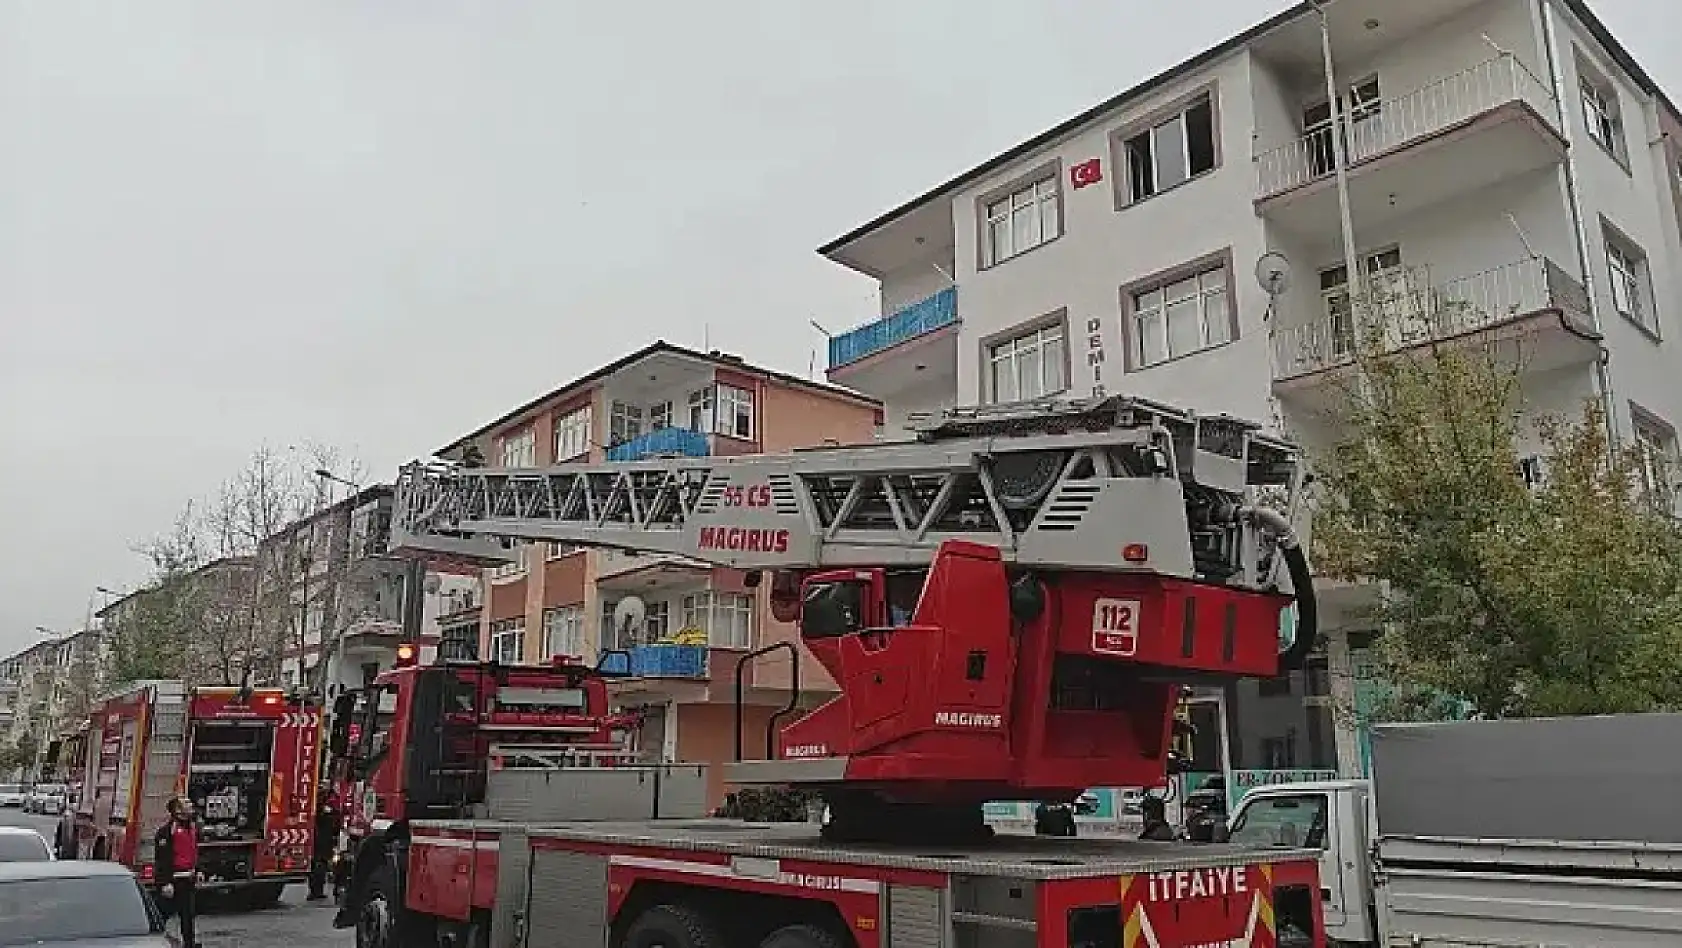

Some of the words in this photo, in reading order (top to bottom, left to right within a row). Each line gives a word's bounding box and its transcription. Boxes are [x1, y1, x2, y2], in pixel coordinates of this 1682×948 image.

[748, 484, 771, 507] CS
[698, 527, 790, 552] MAGIRUS
[1101, 604, 1132, 631] 112
[935, 711, 1002, 729] MAGIRUS
